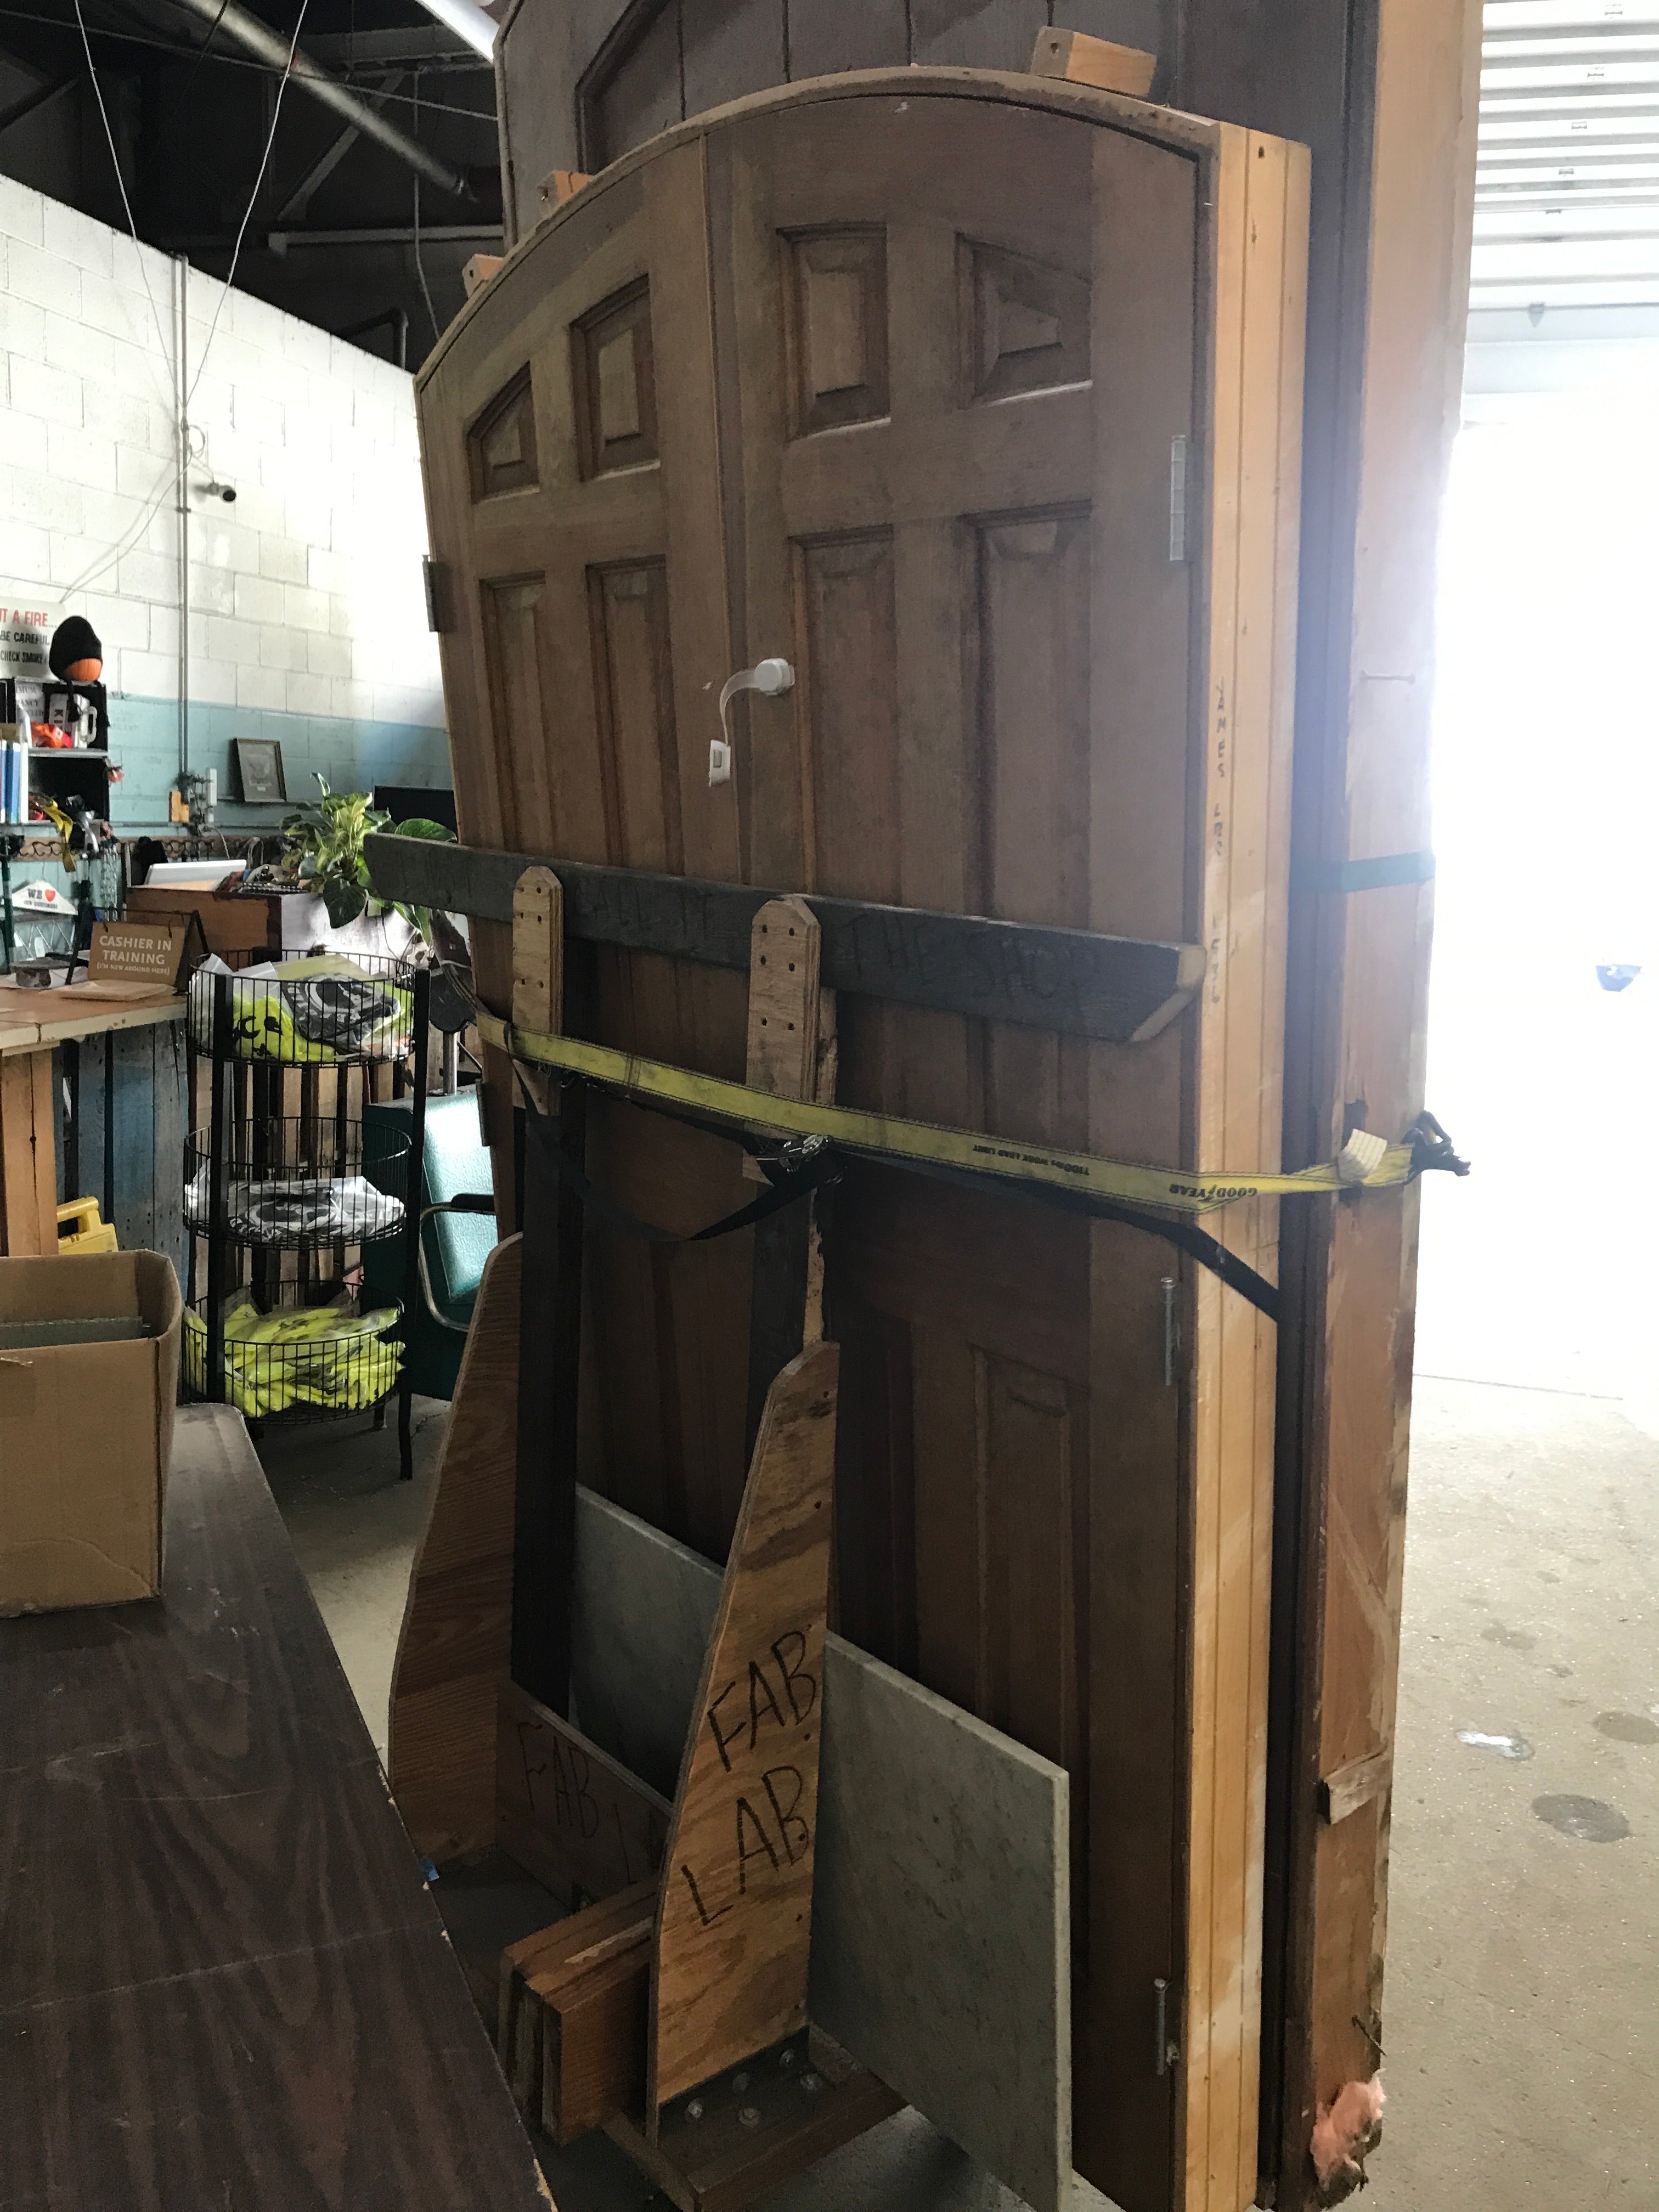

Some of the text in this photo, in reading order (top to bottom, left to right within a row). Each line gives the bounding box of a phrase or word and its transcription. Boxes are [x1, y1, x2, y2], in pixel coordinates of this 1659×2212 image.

[12, 610, 20, 624] A
[1, 650, 20, 662] CHECK
[27, 888, 43, 900] WE
[99, 935, 172, 951] CASHIER IN
[103, 950, 165, 965] TRAINING
[151, 967, 171, 975] HERE)
[1169, 1184, 1258, 1203] GOODYEAR
[707, 1630, 817, 1773] FAB
[517, 1720, 600, 1838] FAB
[681, 1765, 809, 1927] LAB
